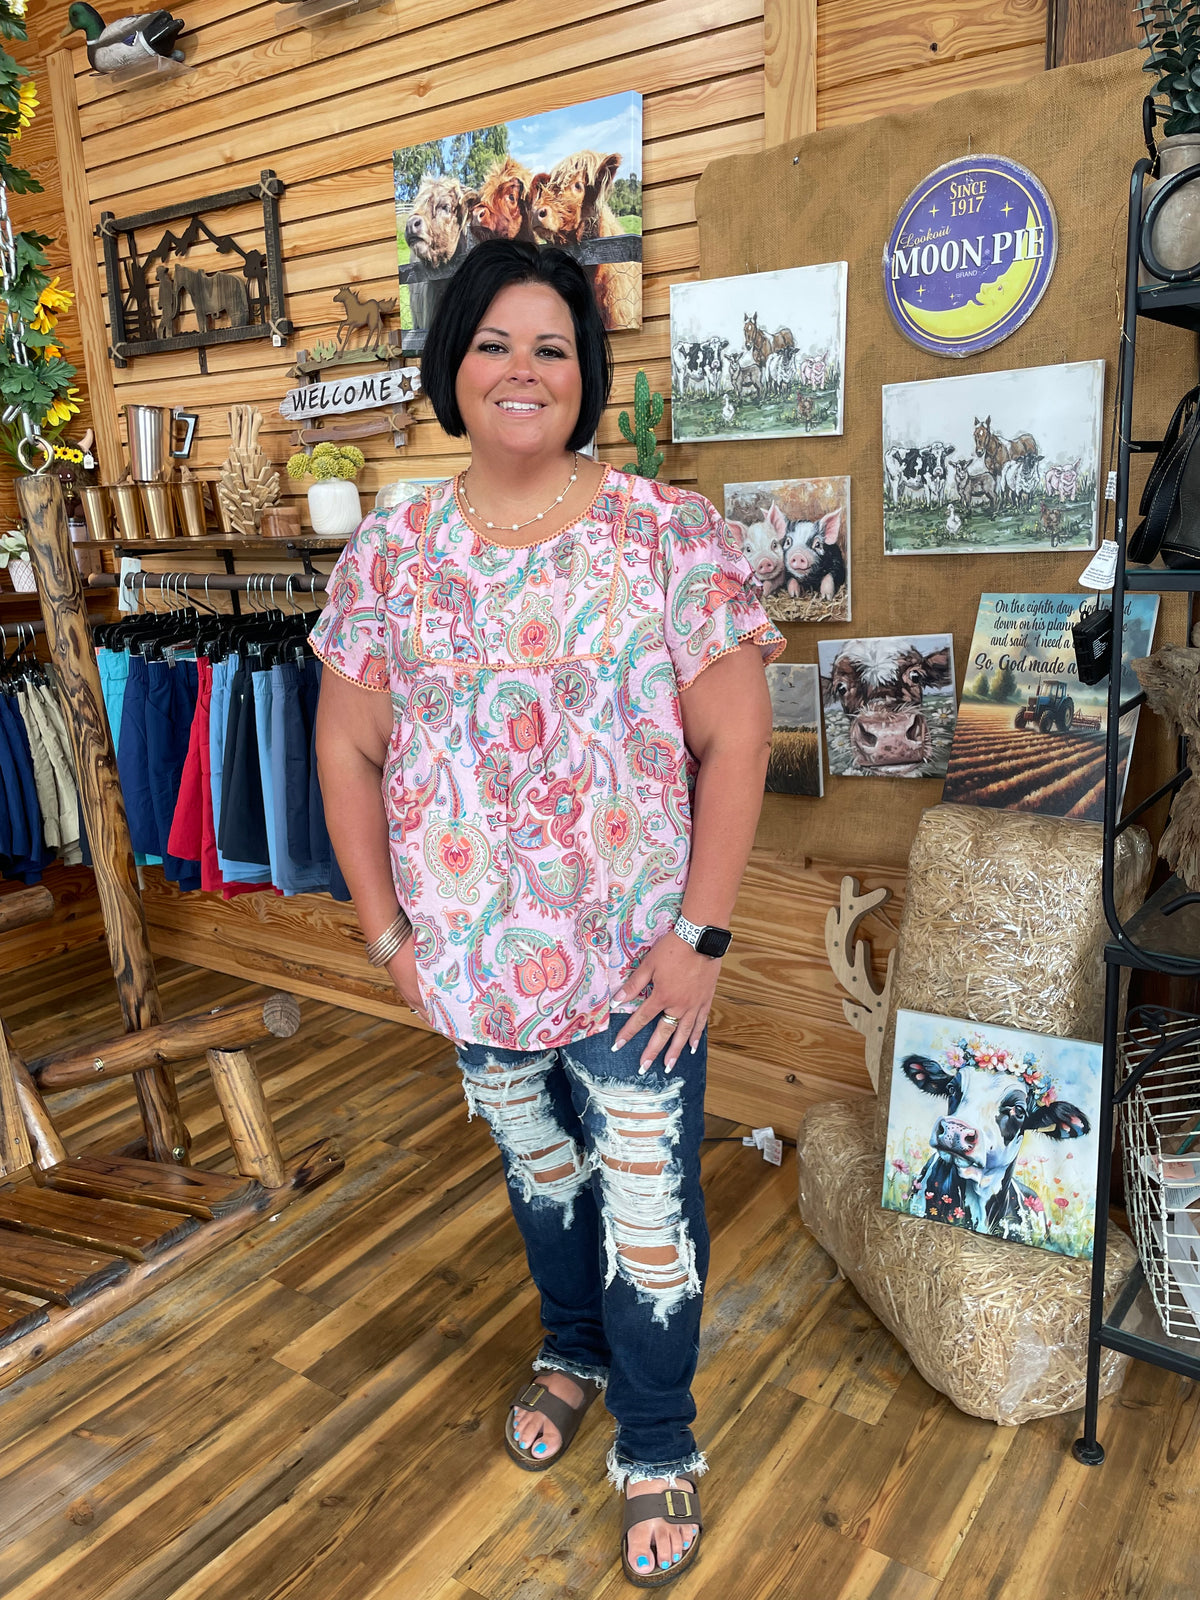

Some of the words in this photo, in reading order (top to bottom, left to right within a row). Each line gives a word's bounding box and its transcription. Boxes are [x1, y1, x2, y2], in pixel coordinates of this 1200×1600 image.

[950, 180, 987, 200] SINCE
[950, 196, 985, 217] 1917
[900, 225, 952, 249] Lookout
[893, 236, 985, 280] MOON
[991, 226, 1045, 265] PIE
[955, 269, 978, 279] BRAND
[292, 377, 392, 412] WELCOME
[995, 599, 1009, 614] On
[1010, 598, 1025, 613] the
[1026, 599, 1054, 616] eighth
[994, 616, 1018, 630] down
[1019, 620, 1032, 630] on
[1032, 618, 1046, 631] his
[990, 633, 1009, 647] and
[1041, 635, 1063, 649] need
[1064, 639, 1071, 649] a
[975, 652, 994, 671] So,
[998, 653, 1027, 672] God
[1029, 656, 1066, 674] made
[1067, 661, 1078, 674] a
